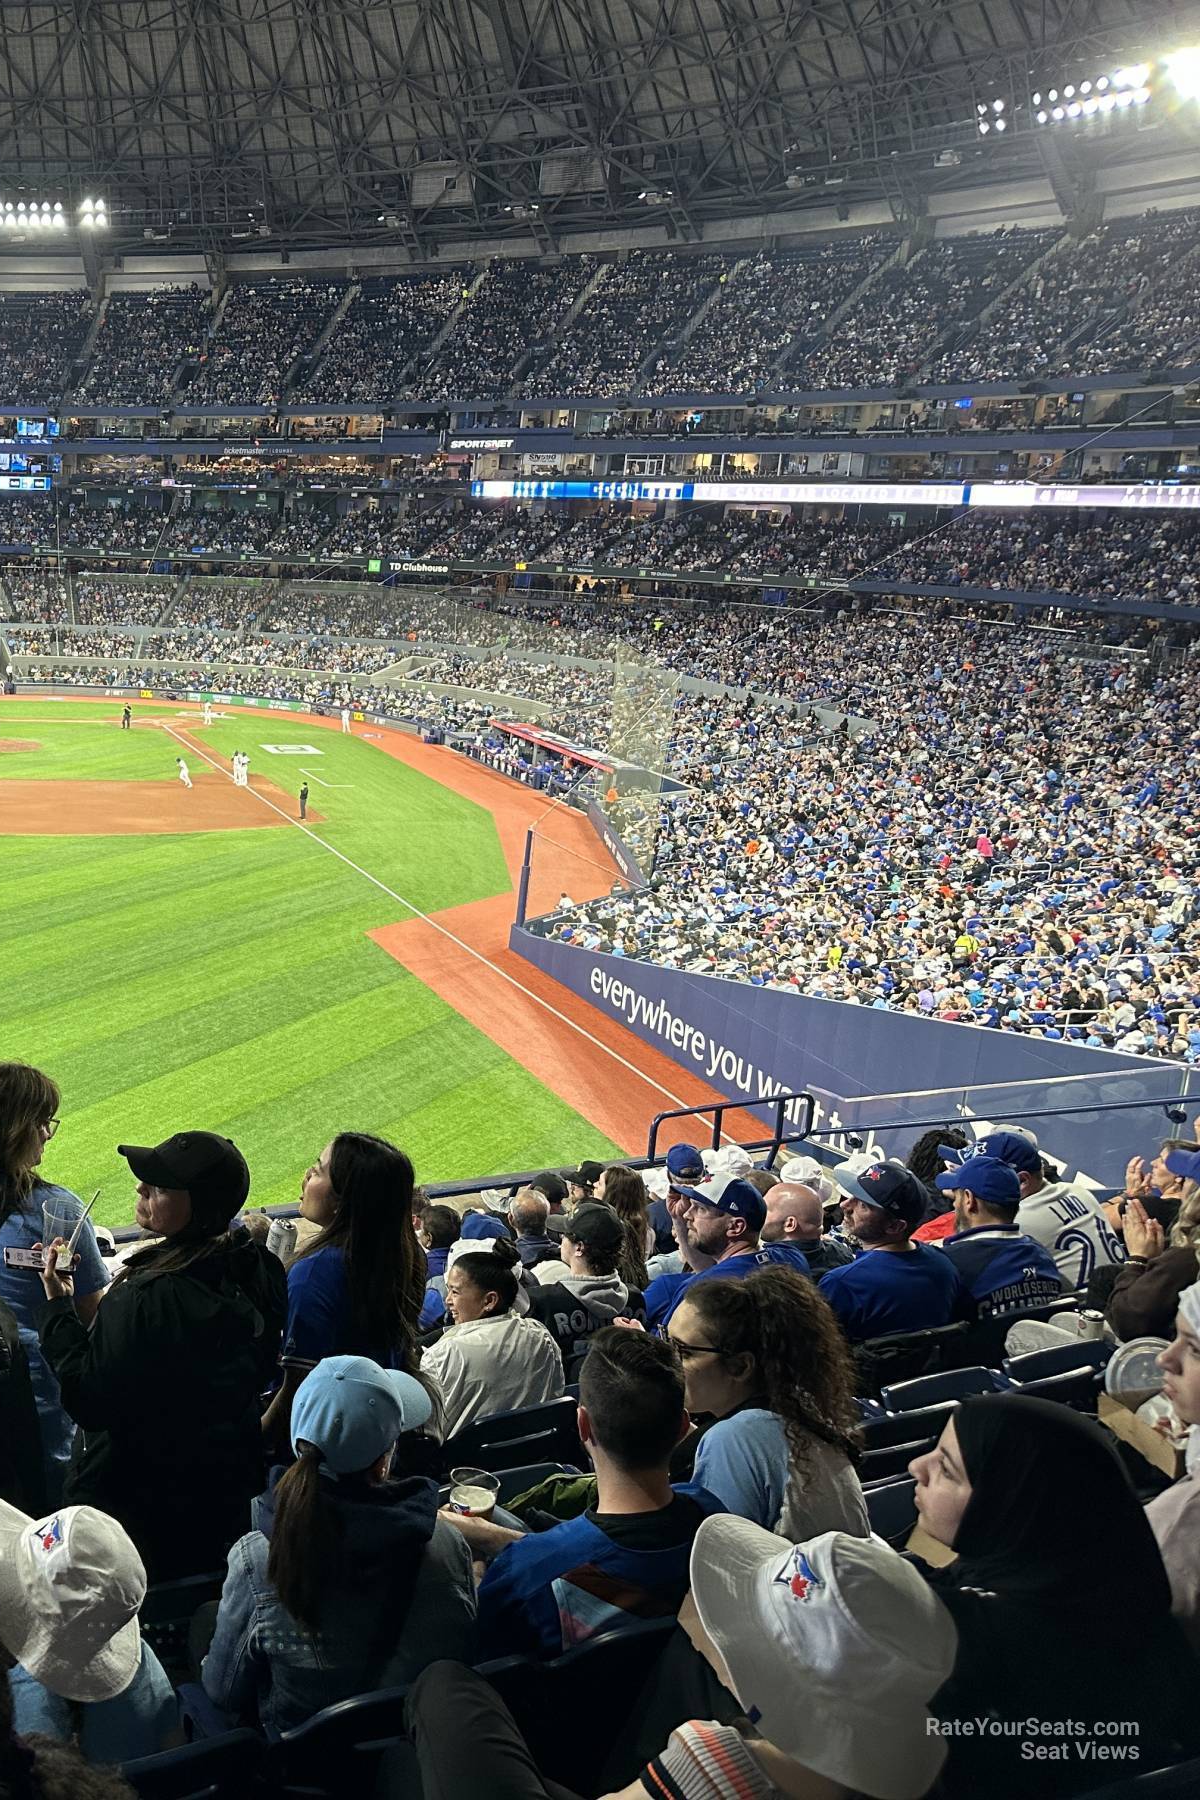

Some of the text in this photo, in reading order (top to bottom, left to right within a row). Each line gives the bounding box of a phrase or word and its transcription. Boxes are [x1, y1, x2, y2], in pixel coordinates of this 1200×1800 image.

[223, 446, 264, 455] ticketmaster
[450, 439, 514, 449] SPORTSNET
[390, 562, 449, 573] TD Clubhouse
[590, 967, 706, 1061] everywhere
[705, 1039, 753, 1093] you
[1048, 1195, 1090, 1226] LIND
[991, 1281, 1031, 1303] WORLD
